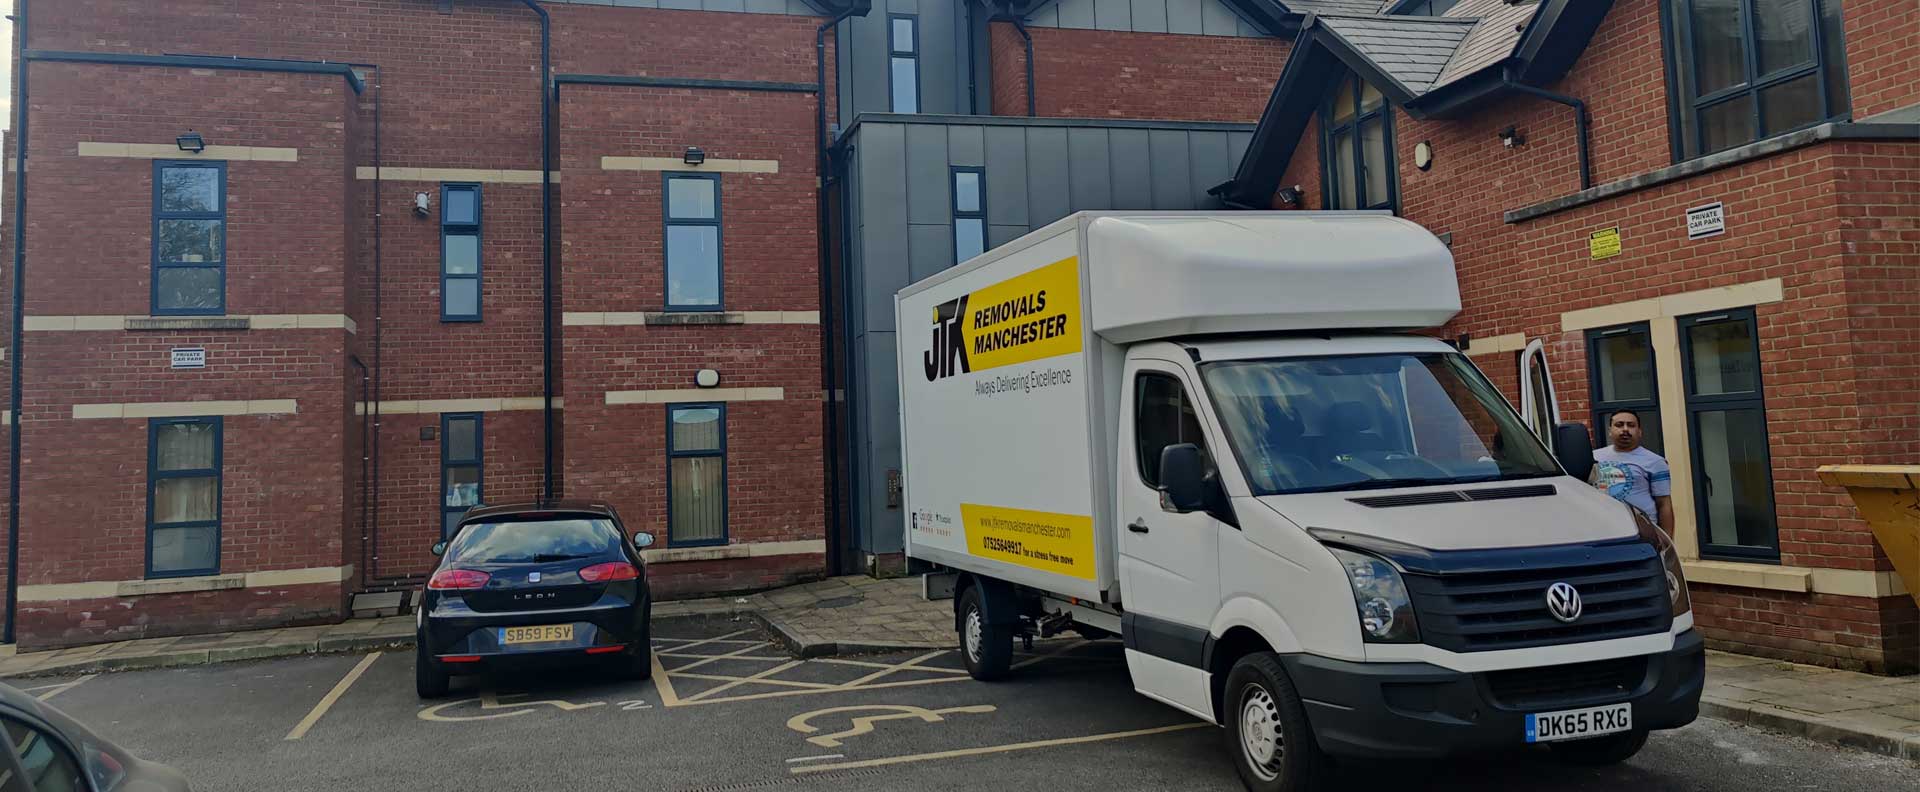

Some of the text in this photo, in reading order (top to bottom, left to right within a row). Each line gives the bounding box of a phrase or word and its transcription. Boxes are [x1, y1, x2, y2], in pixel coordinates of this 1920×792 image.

[1690, 216, 1722, 229] CAR PARK
[1691, 211, 1717, 221] PRIVATE
[974, 290, 1046, 330] REMOVALS
[974, 313, 1067, 355] MANCHESTER
[975, 367, 1072, 397] Always Delivering Excellence
[982, 536, 1022, 555] 07525649917
[1034, 549, 1048, 561] stress
[1048, 551, 1059, 563] free
[1059, 555, 1073, 566] move
[514, 592, 555, 600] LEON
[507, 627, 571, 641] SB59 FSV
[1539, 713, 1588, 737] DK65
[1594, 708, 1627, 731] RXG
